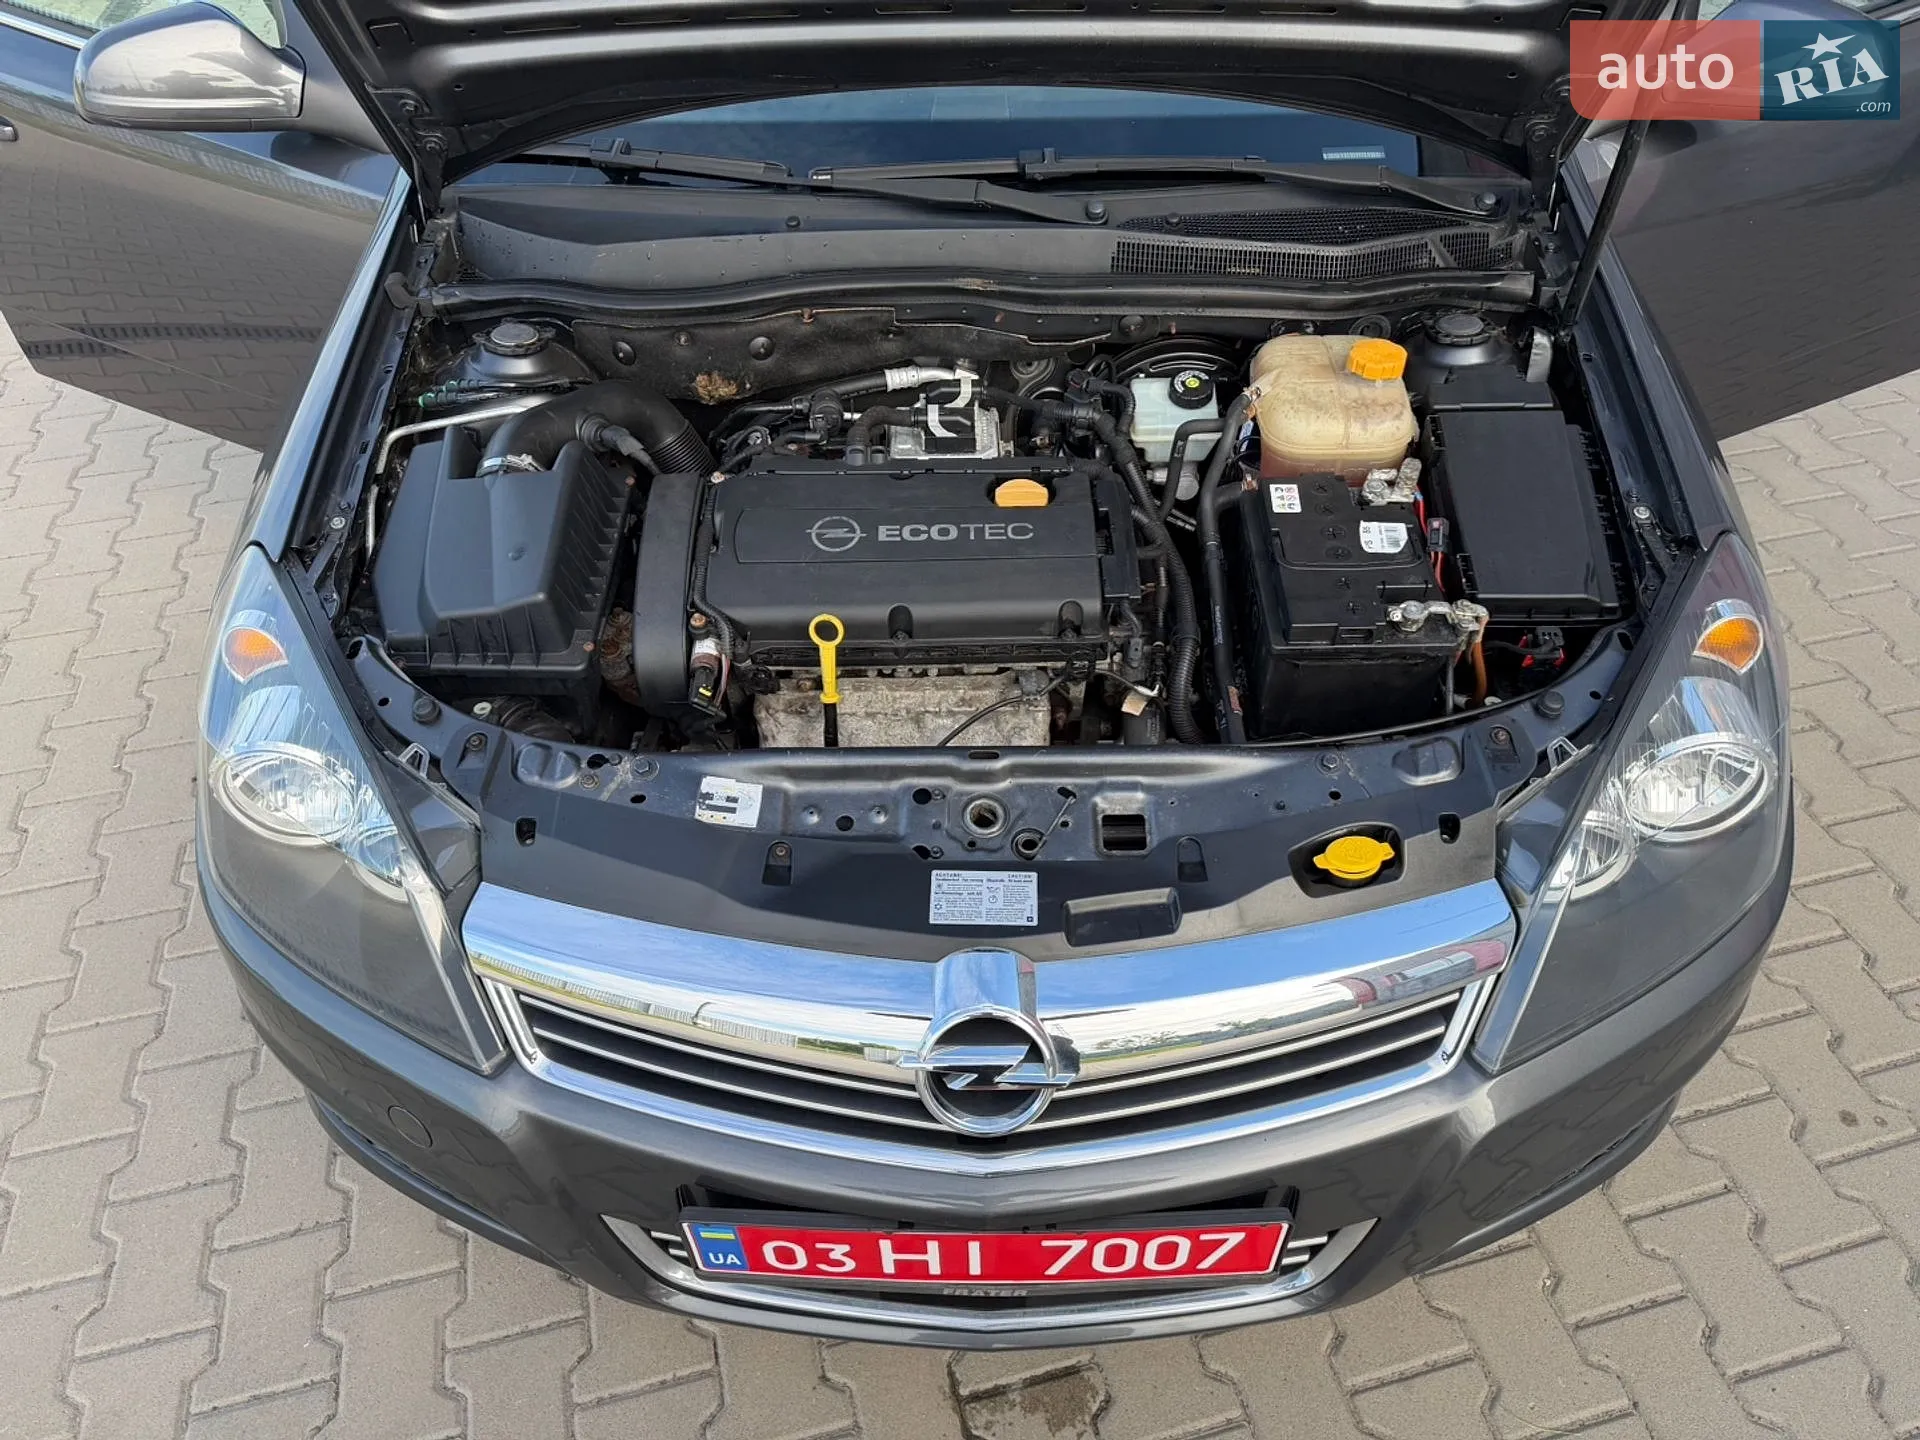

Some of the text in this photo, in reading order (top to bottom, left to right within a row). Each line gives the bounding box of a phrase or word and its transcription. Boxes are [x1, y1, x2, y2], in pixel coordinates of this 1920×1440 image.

[877, 522, 1034, 542] ECOTEC
[708, 1252, 742, 1266] UA
[762, 1240, 856, 1273] 03
[1040, 1231, 1246, 1276] 7007
